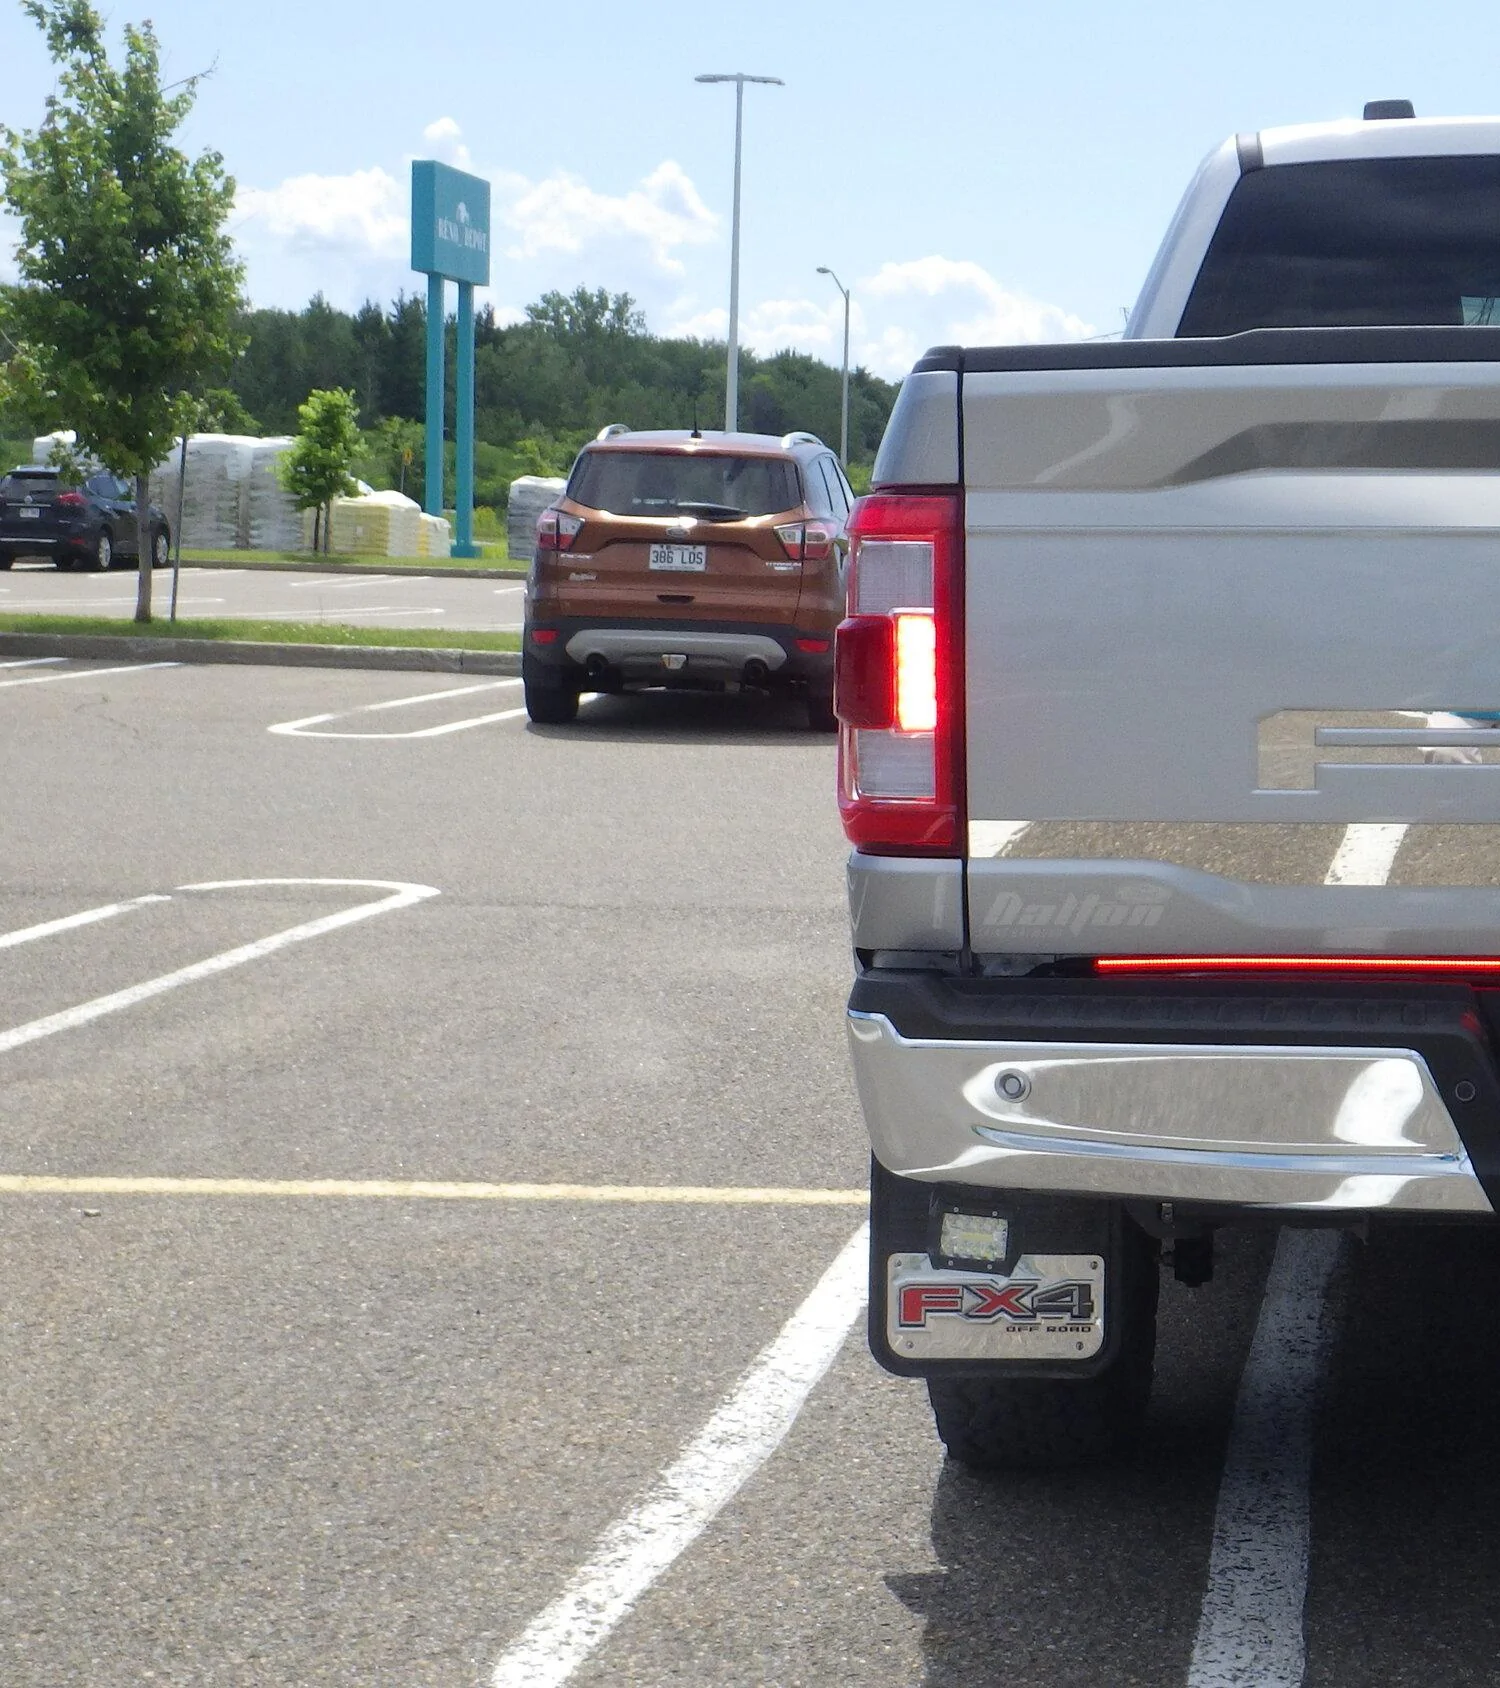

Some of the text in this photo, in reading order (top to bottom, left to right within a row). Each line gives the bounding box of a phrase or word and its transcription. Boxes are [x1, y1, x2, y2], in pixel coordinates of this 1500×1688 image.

[652, 550, 703, 565] 386 LDS
[899, 1283, 1095, 1328] FX4
[1006, 1325, 1092, 1333] OFF ROAD
